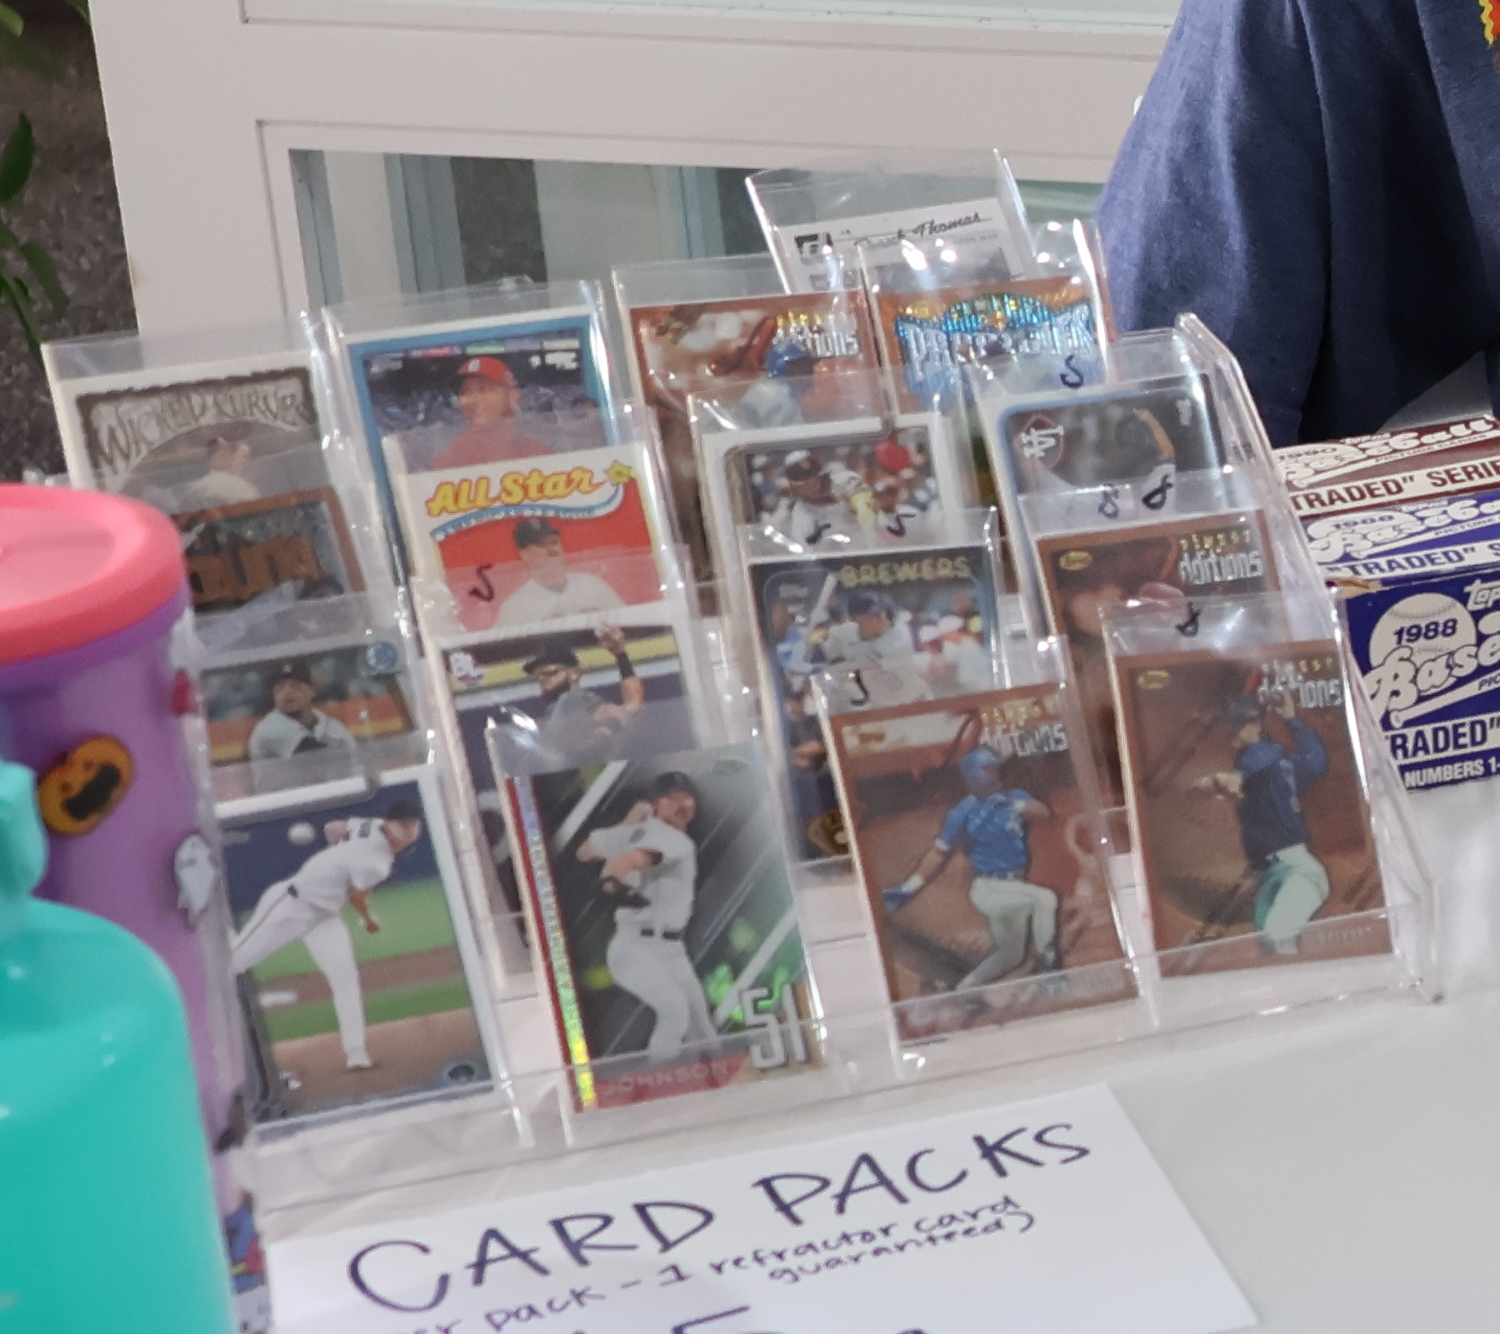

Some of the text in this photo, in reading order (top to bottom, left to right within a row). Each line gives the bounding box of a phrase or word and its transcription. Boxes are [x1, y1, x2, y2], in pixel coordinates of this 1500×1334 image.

[499, 467, 605, 506] Star
[1393, 618, 1459, 646] 1988
[1403, 758, 1485, 789] NUMBERS
[740, 983, 808, 1068] 51
[346, 1121, 1092, 1315] CARD PACKS
[484, 1282, 609, 1334] pack
[913, 1195, 1022, 1235] card
